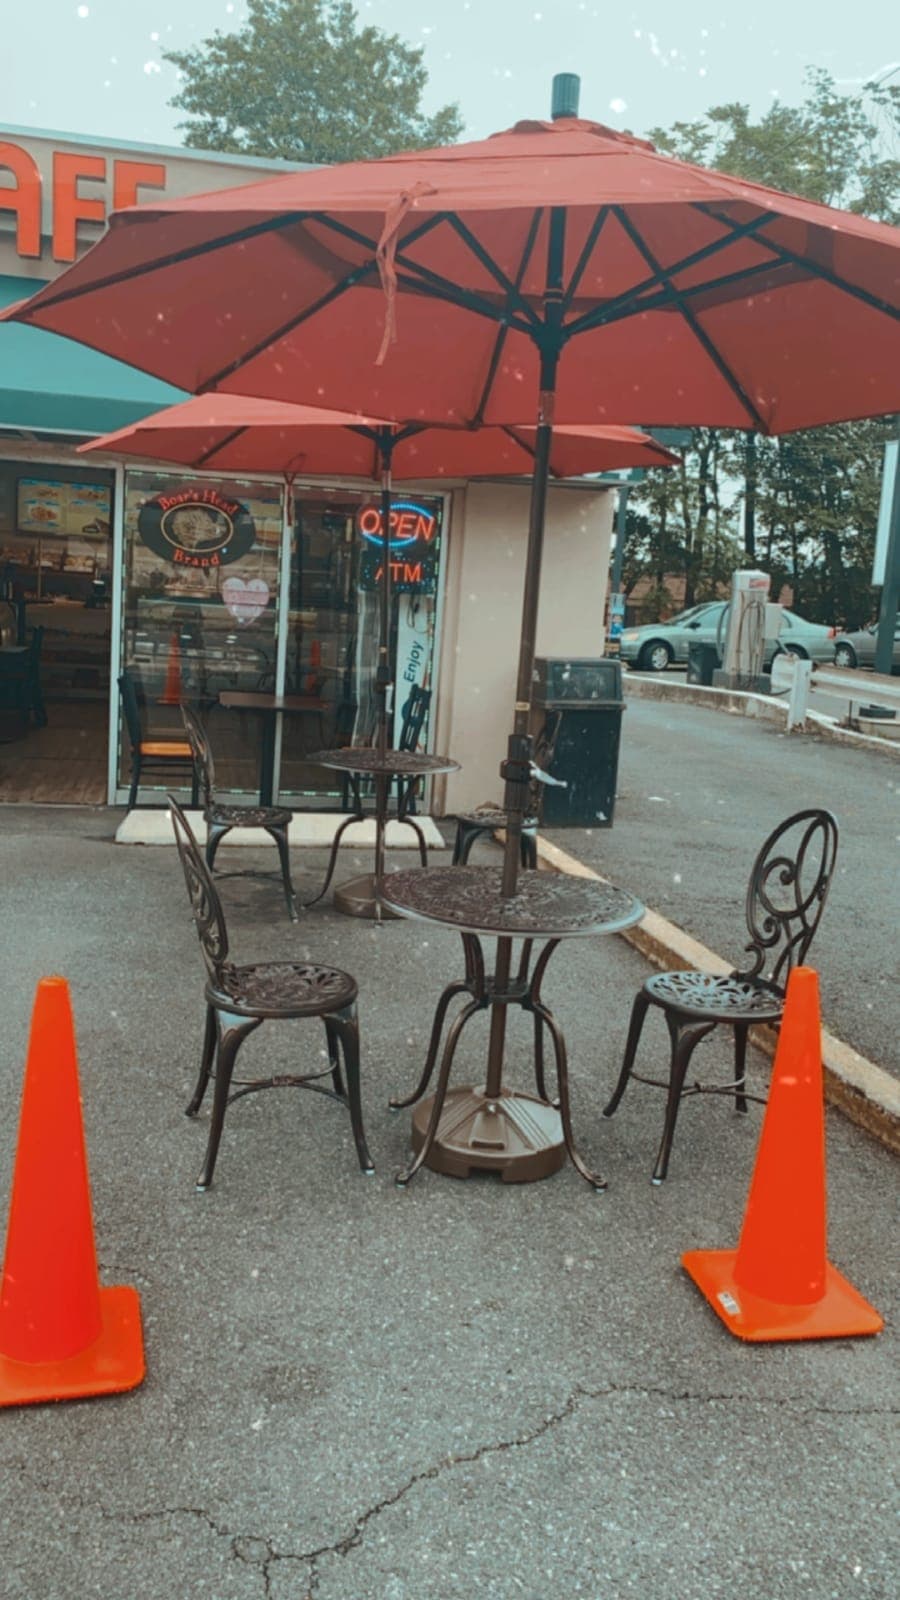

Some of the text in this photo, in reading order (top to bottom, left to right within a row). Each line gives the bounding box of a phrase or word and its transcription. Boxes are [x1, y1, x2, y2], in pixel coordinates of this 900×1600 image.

[158, 488, 239, 516] Boar's Head
[360, 509, 435, 541] OPEN
[173, 548, 220, 567] Brand
[403, 640, 425, 682] Enjoy
